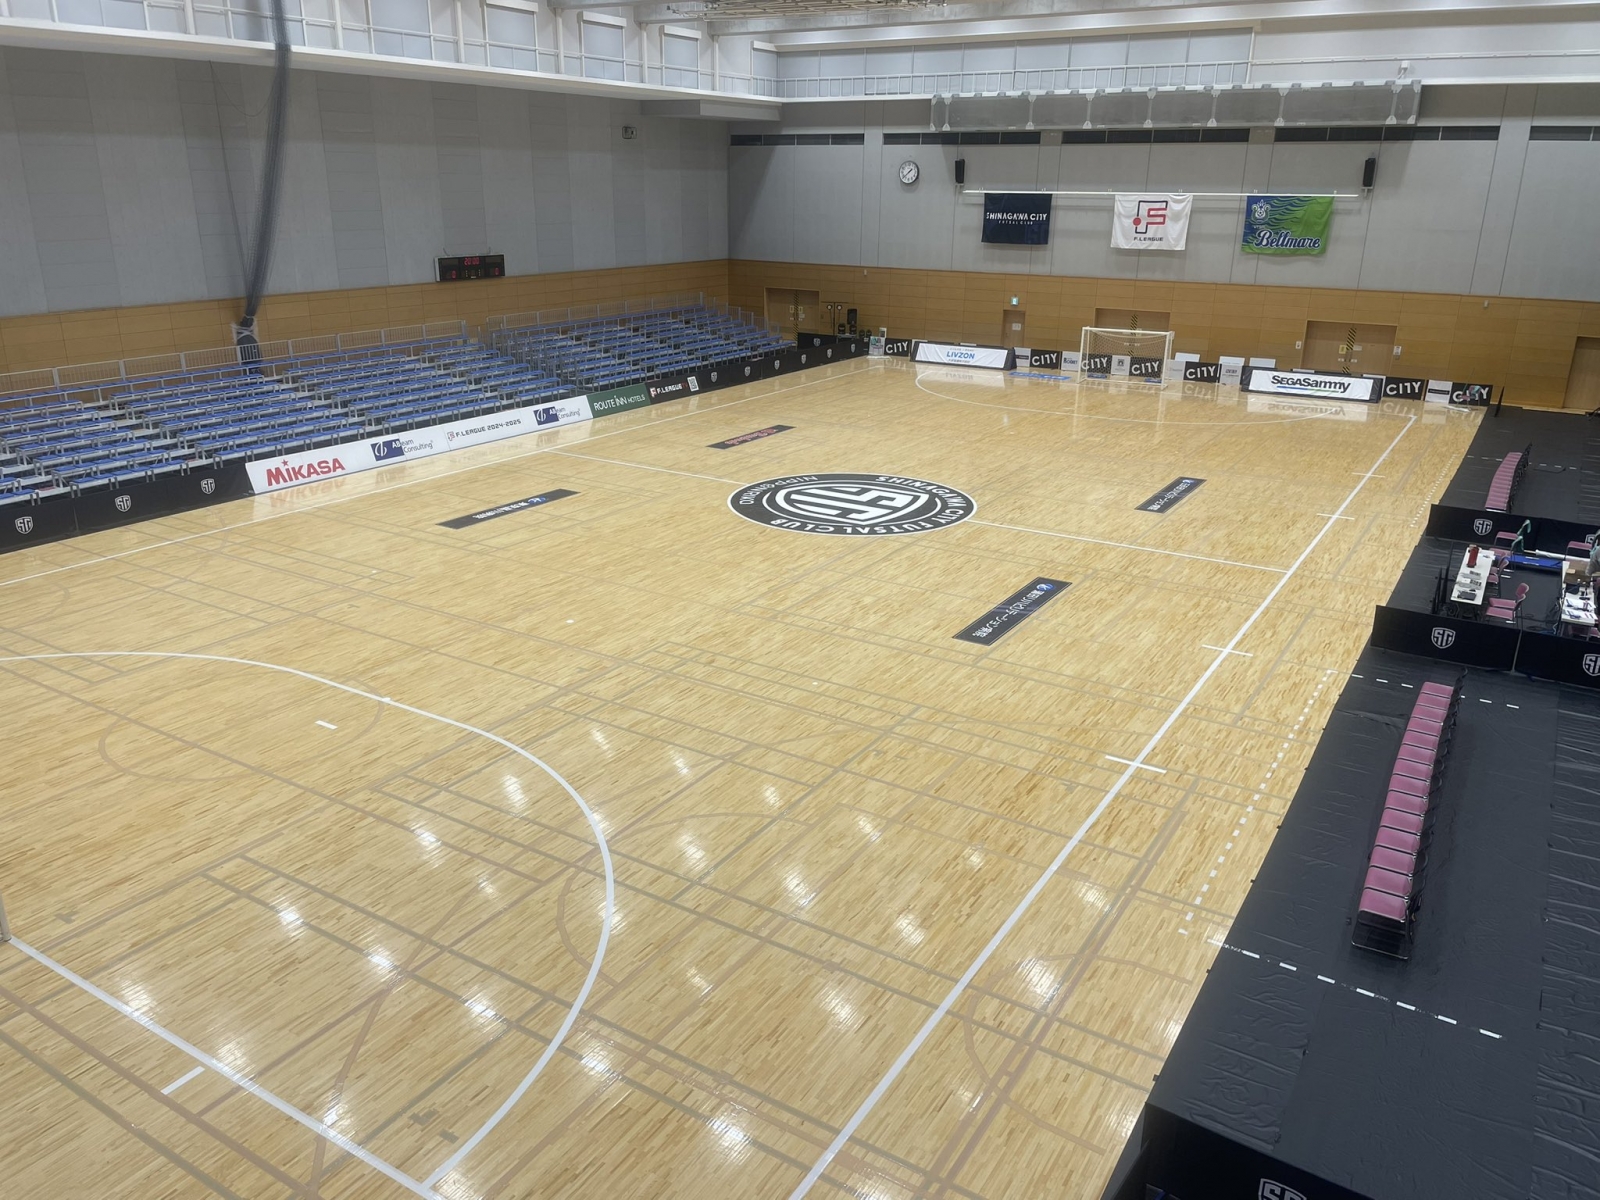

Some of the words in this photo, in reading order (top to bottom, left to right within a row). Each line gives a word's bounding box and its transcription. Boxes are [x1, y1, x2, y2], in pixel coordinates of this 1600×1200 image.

[1030, 213, 1047, 221] CITY
[1253, 229, 1321, 249] Bellmare
[885, 341, 909, 354] CITY
[946, 351, 975, 360] LIVZON
[1032, 352, 1057, 366] CITY
[1081, 357, 1108, 370] CITY
[1131, 361, 1160, 375] CITY
[1186, 365, 1216, 379] CITY
[1386, 381, 1421, 395] CITY
[593, 399, 616, 411] ROUTE
[487, 419, 522, 431] 2024-2025
[403, 441, 433, 454] Consulting
[770, 519, 835, 532] CLUB
[843, 521, 934, 534] FUTSAL
